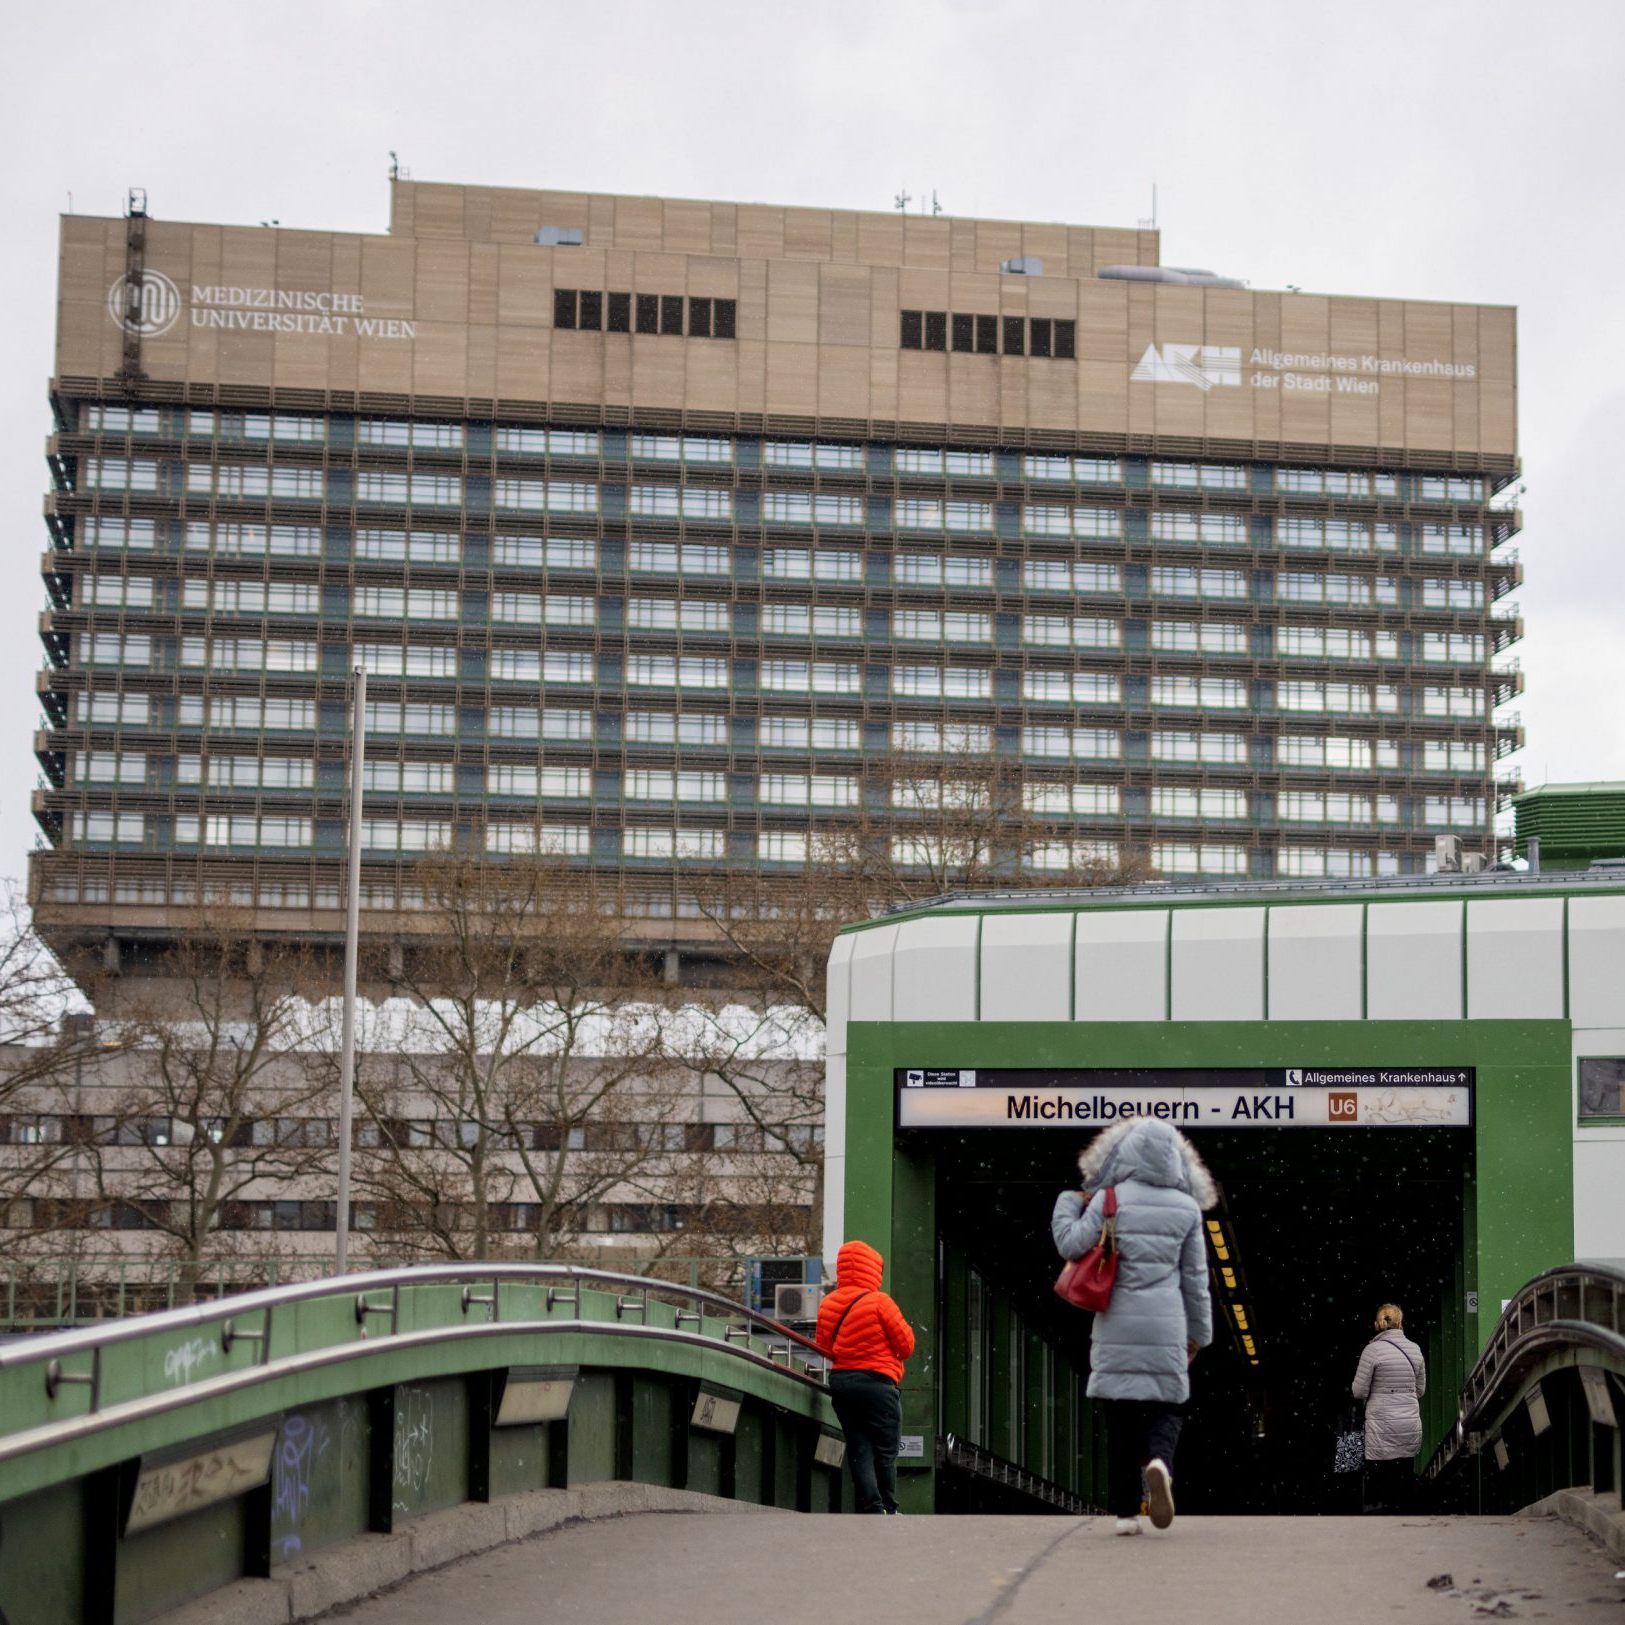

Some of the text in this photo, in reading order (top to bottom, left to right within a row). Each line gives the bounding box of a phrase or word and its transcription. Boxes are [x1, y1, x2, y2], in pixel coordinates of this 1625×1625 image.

[191, 285, 364, 312] MEDIZINISCHE
[190, 307, 418, 338] UNIVERSITÄT WIEN
[1249, 348, 1476, 377] Allgemeines Krankenhaus
[1250, 371, 1380, 395] der Stadt Wien
[1304, 1072, 1456, 1085] Allgemeines Krankenhaus
[1007, 1095, 1199, 1120] Michelbeuern
[1231, 1095, 1294, 1120] AKH
[1329, 1098, 1356, 1115] U6
